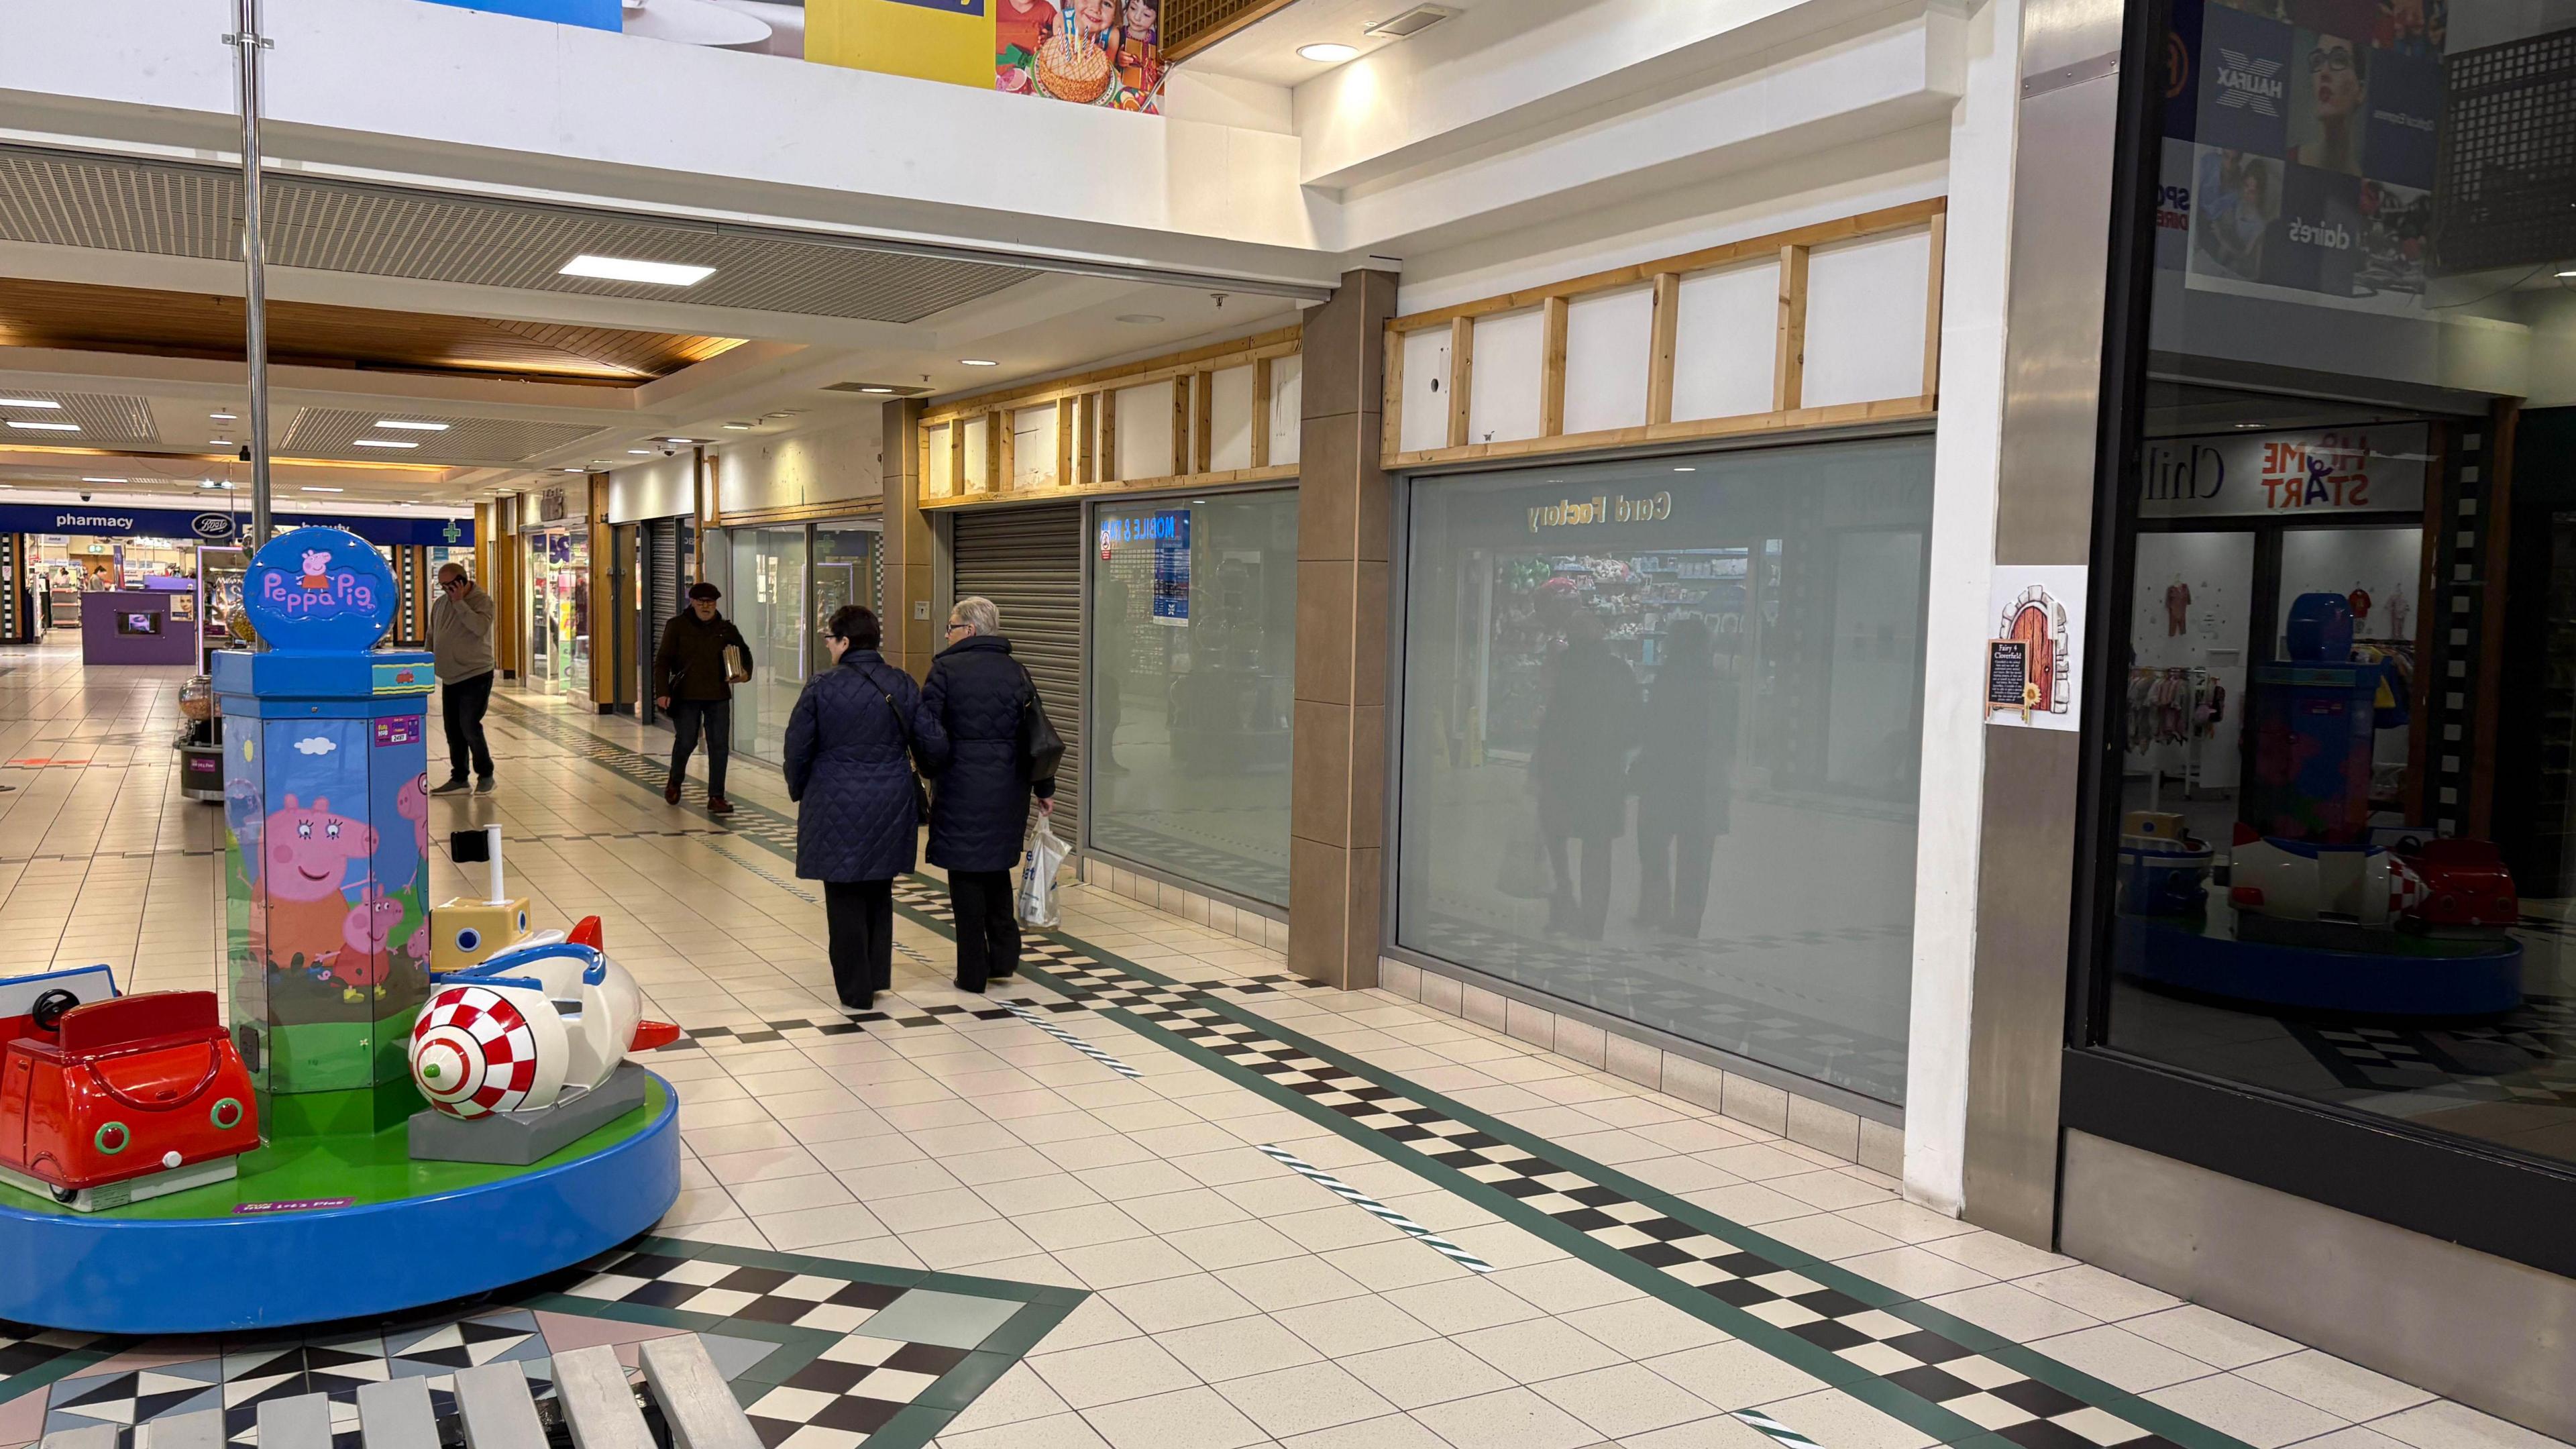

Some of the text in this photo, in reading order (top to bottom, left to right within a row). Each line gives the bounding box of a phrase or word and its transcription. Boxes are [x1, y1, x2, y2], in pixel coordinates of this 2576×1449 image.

[56, 513, 133, 529] pharmacy
[264, 573, 335, 612] Peppa
[337, 574, 370, 606] Pig
